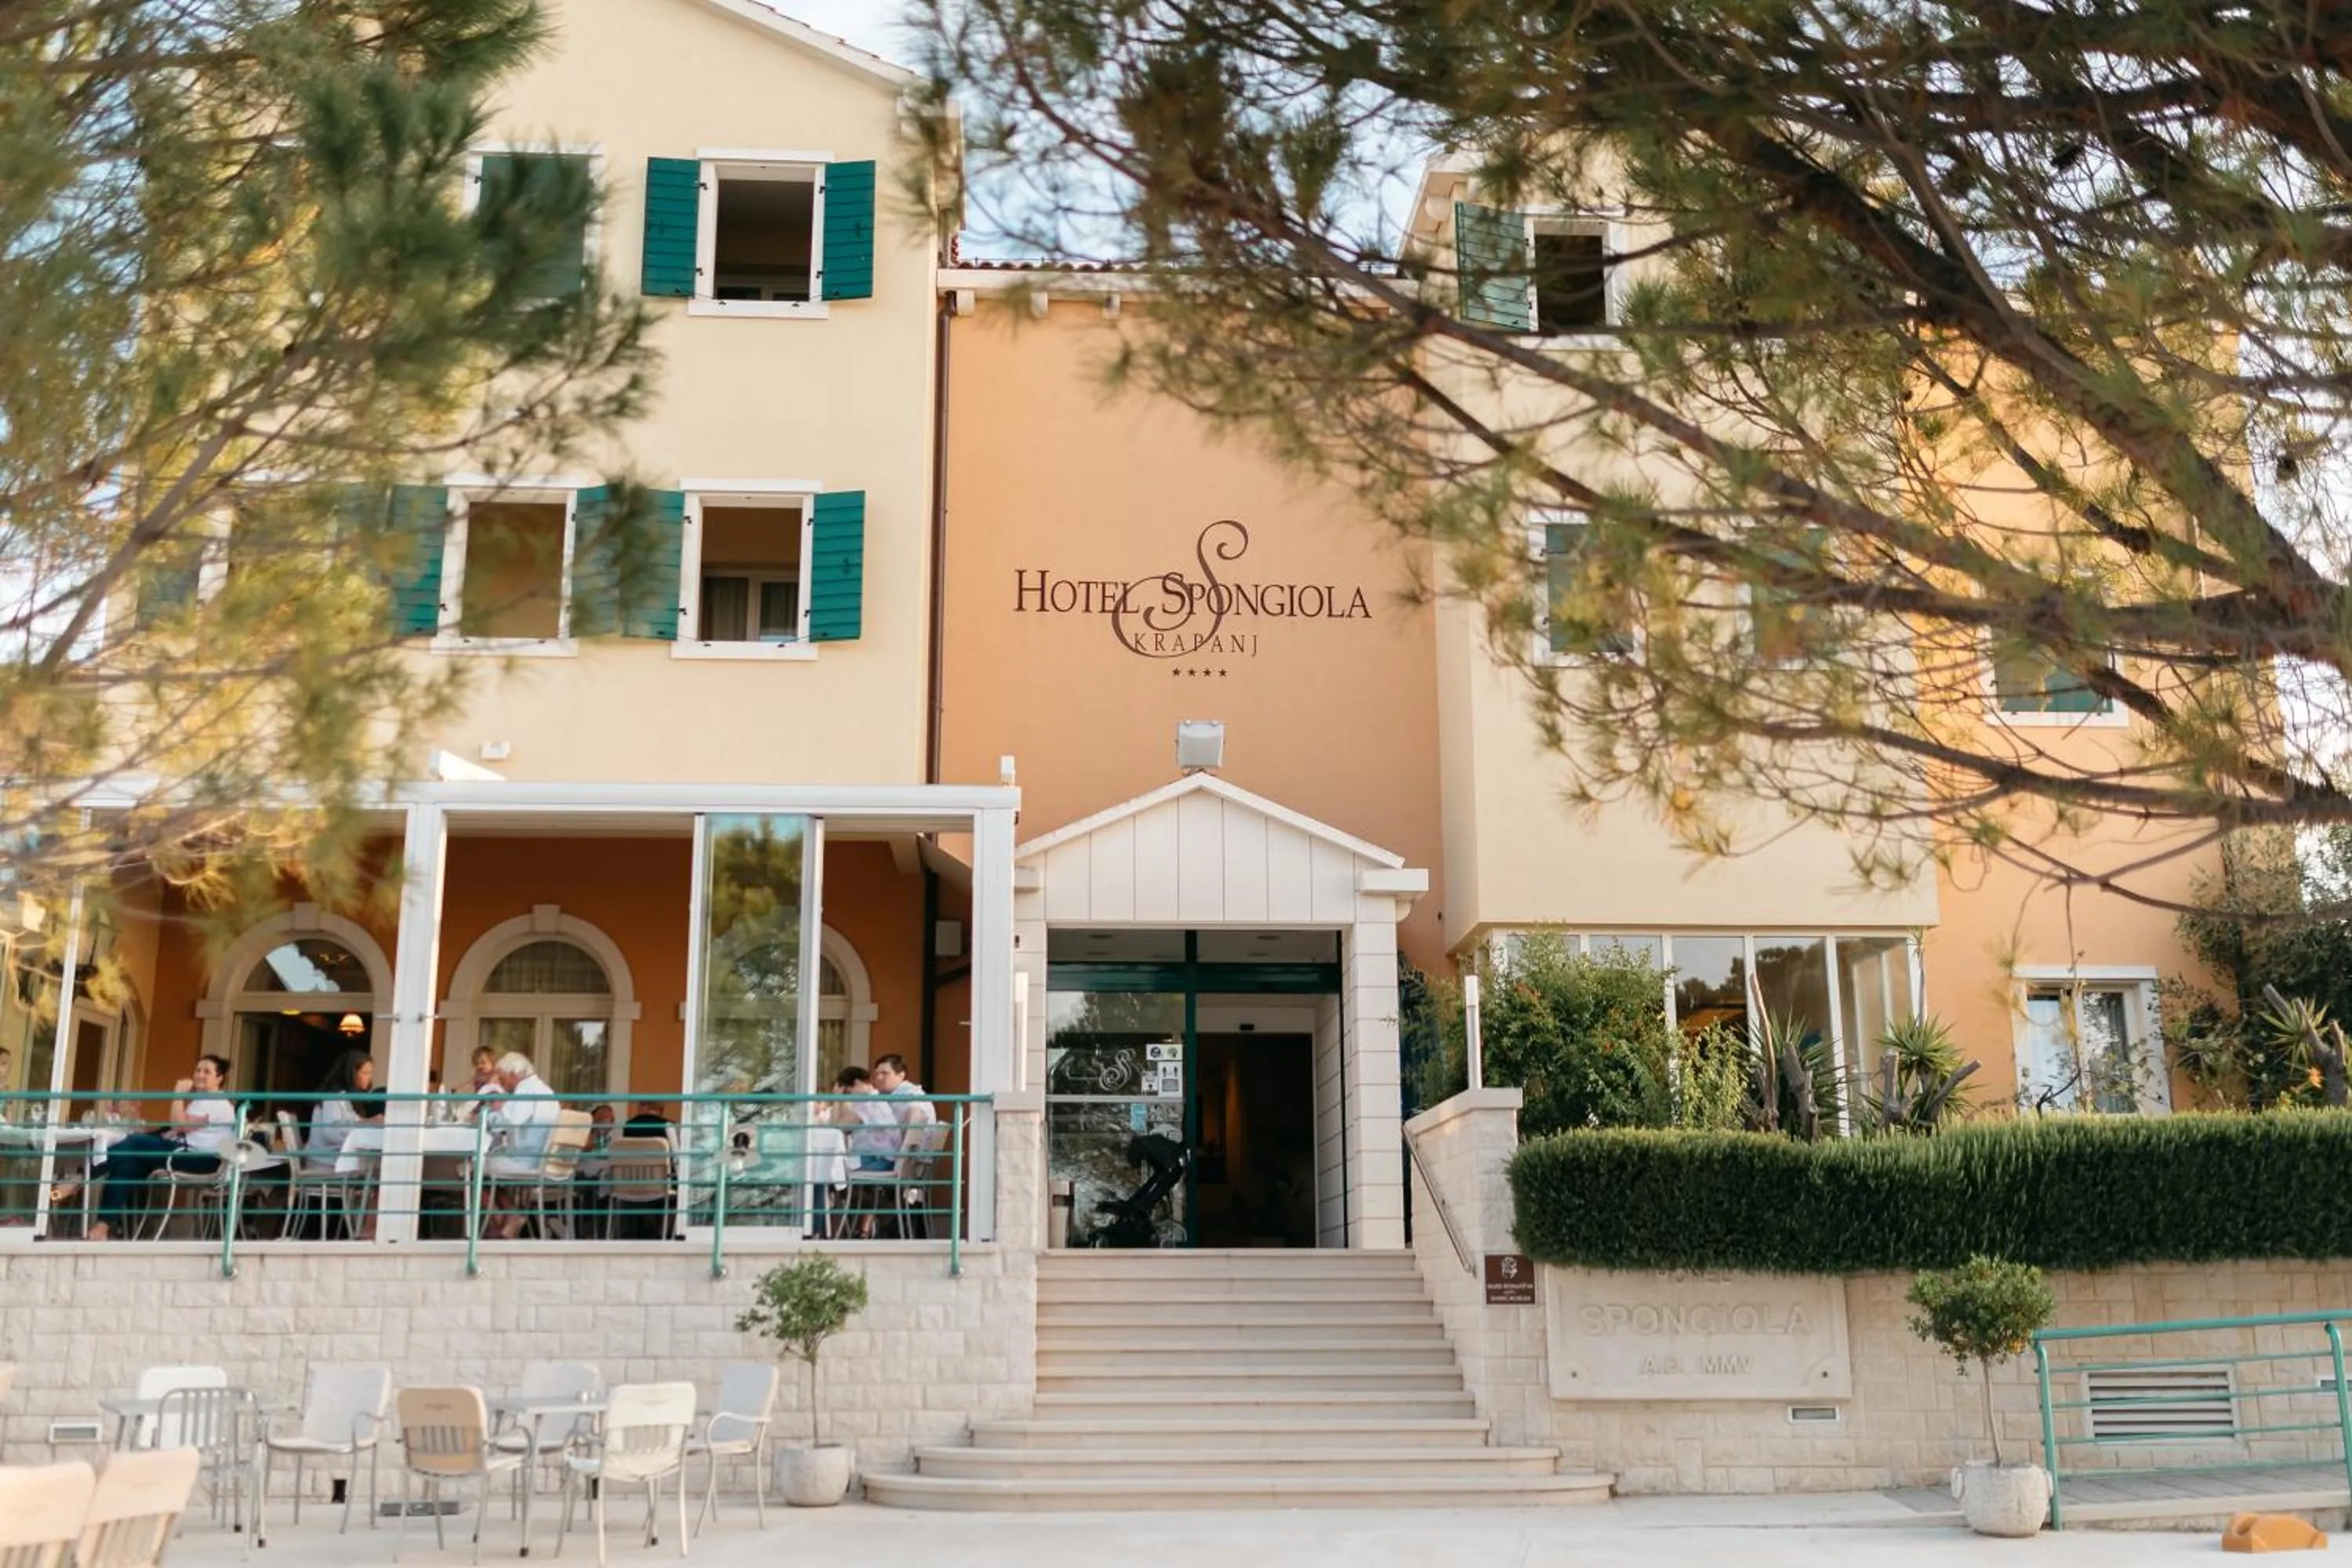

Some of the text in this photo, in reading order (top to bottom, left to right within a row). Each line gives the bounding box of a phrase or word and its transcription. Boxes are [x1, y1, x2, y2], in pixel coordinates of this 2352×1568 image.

[1014, 569, 1373, 619] HOTEL SPONGIOLA
[1133, 632, 1258, 657] KRAPANJ
[1579, 1303, 1814, 1336] SPONGIOLA
